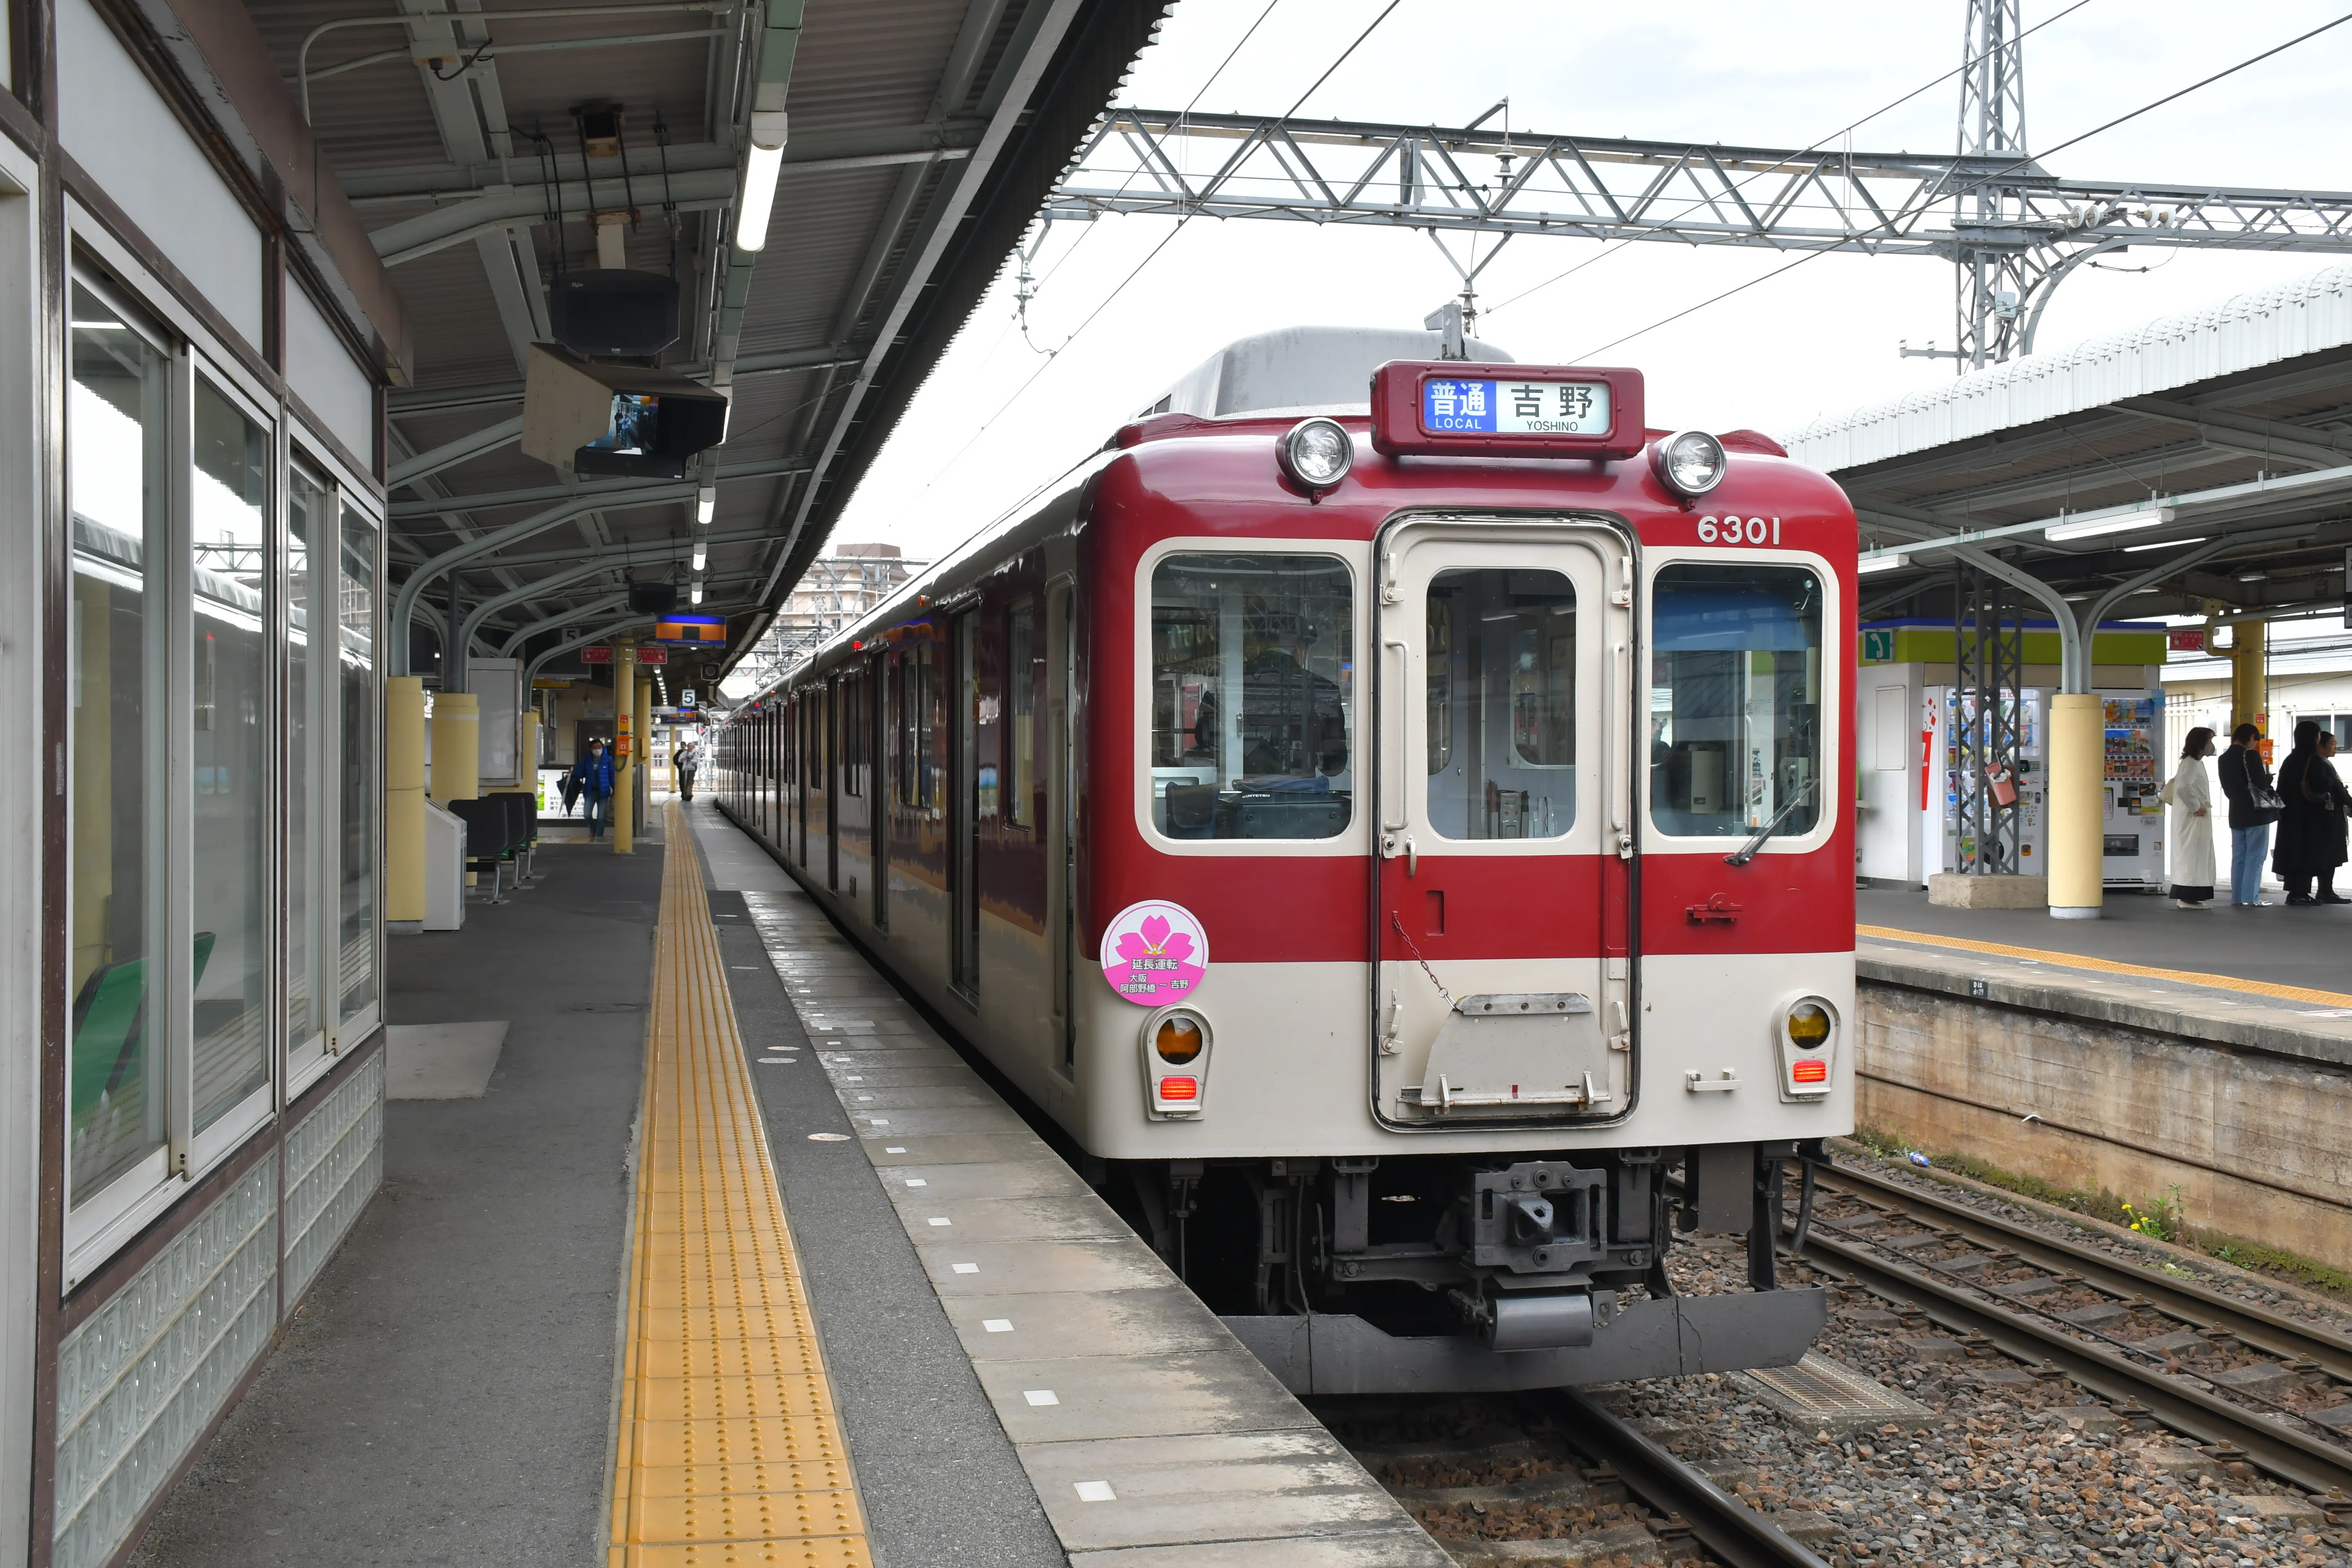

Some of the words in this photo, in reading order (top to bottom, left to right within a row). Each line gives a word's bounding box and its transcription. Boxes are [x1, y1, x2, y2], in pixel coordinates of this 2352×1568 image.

[1431, 382, 1486, 416] 普通
[1511, 384, 1593, 419] 吉野
[1435, 418, 1481, 429] LOCAL
[1527, 421, 1578, 432] YOSHINO
[1698, 516, 1780, 545] 6301
[684, 692, 693, 704] 5
[1132, 958, 1178, 970] 延長運転
[1129, 973, 1147, 983] 大阪
[1120, 983, 1156, 994] 阿部野橋
[1171, 979, 1189, 989] 吉野
